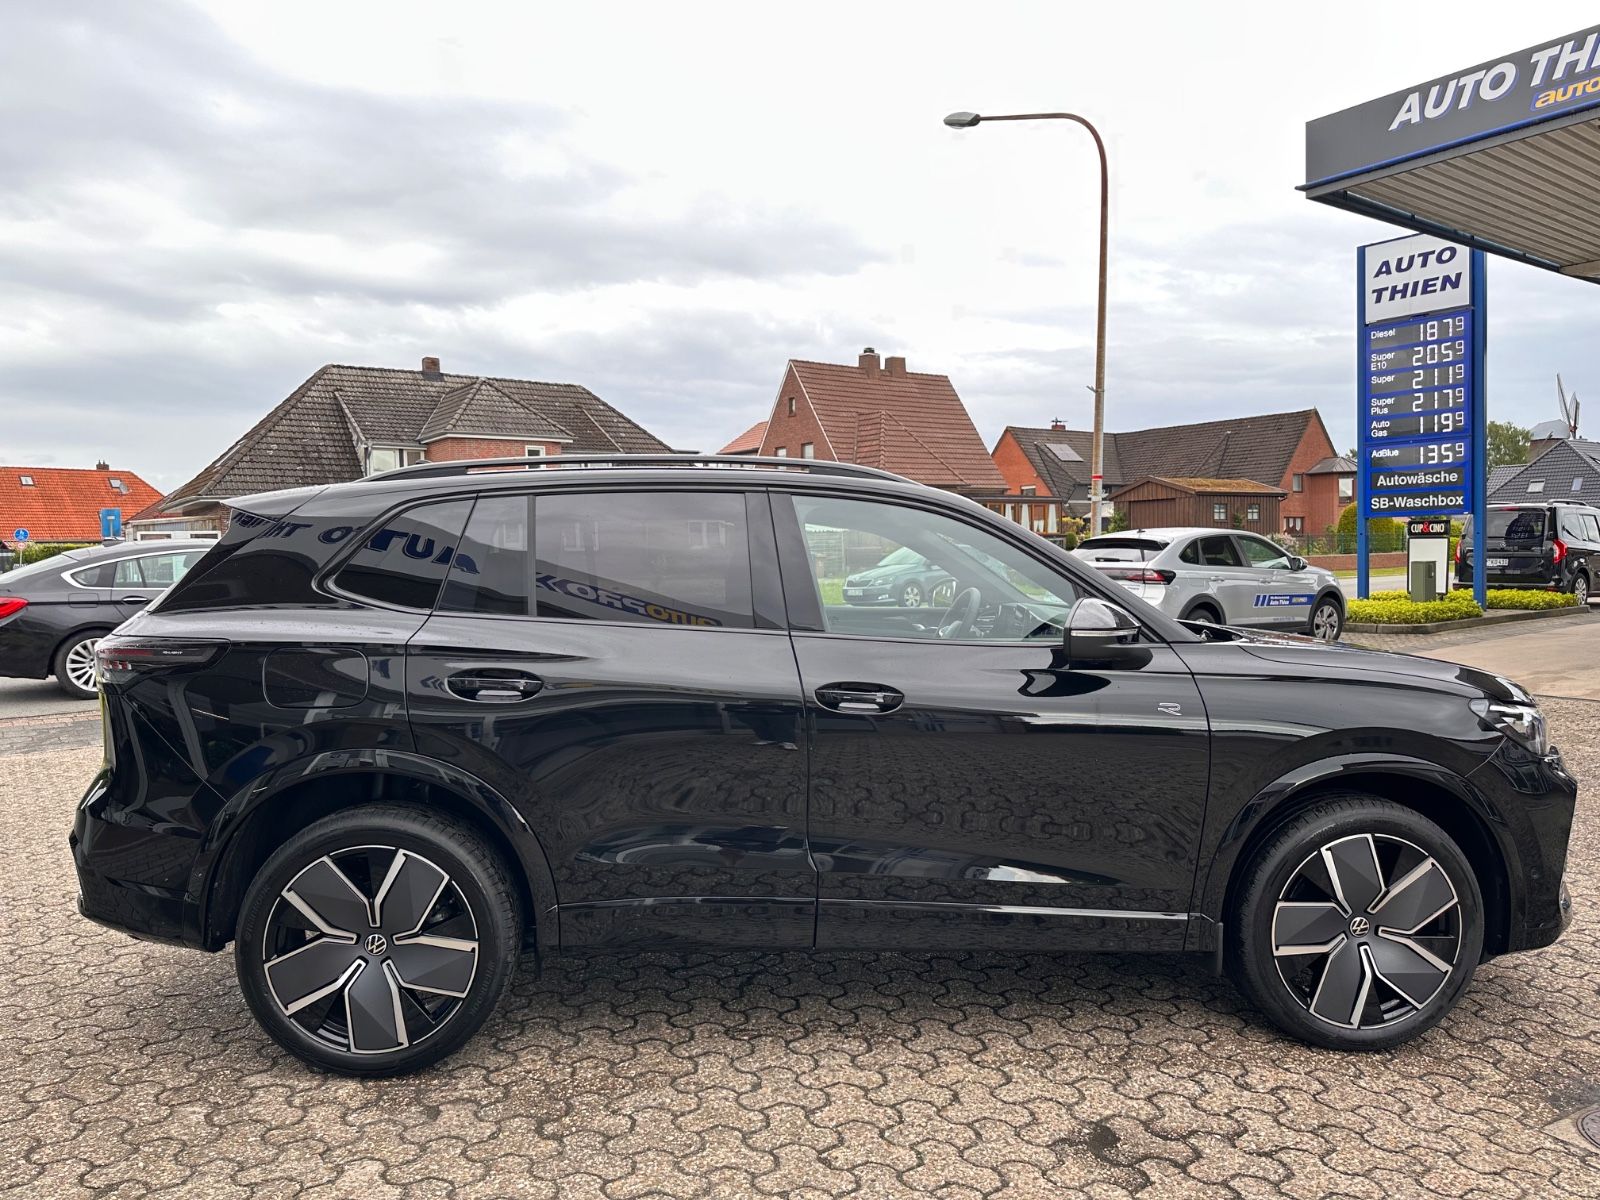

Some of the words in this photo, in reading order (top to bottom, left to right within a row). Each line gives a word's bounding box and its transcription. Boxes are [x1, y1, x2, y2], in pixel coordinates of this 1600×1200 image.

[1388, 62, 1518, 131] AUTO
[1373, 246, 1457, 278] AUTO
[1371, 272, 1462, 304] THIEN
[1371, 328, 1396, 339] Diesel
[1371, 352, 1395, 362] Super
[1371, 361, 1387, 371] E10
[1371, 375, 1395, 385] Super
[1371, 397, 1395, 407] Super
[1371, 406, 1388, 415] Plus
[1371, 420, 1390, 429] Auto
[1371, 429, 1388, 437] Gas
[1371, 449, 1399, 458] AdBlue
[1377, 471, 1458, 486] Autowäsche
[1371, 495, 1464, 509] SB-Waschbox
